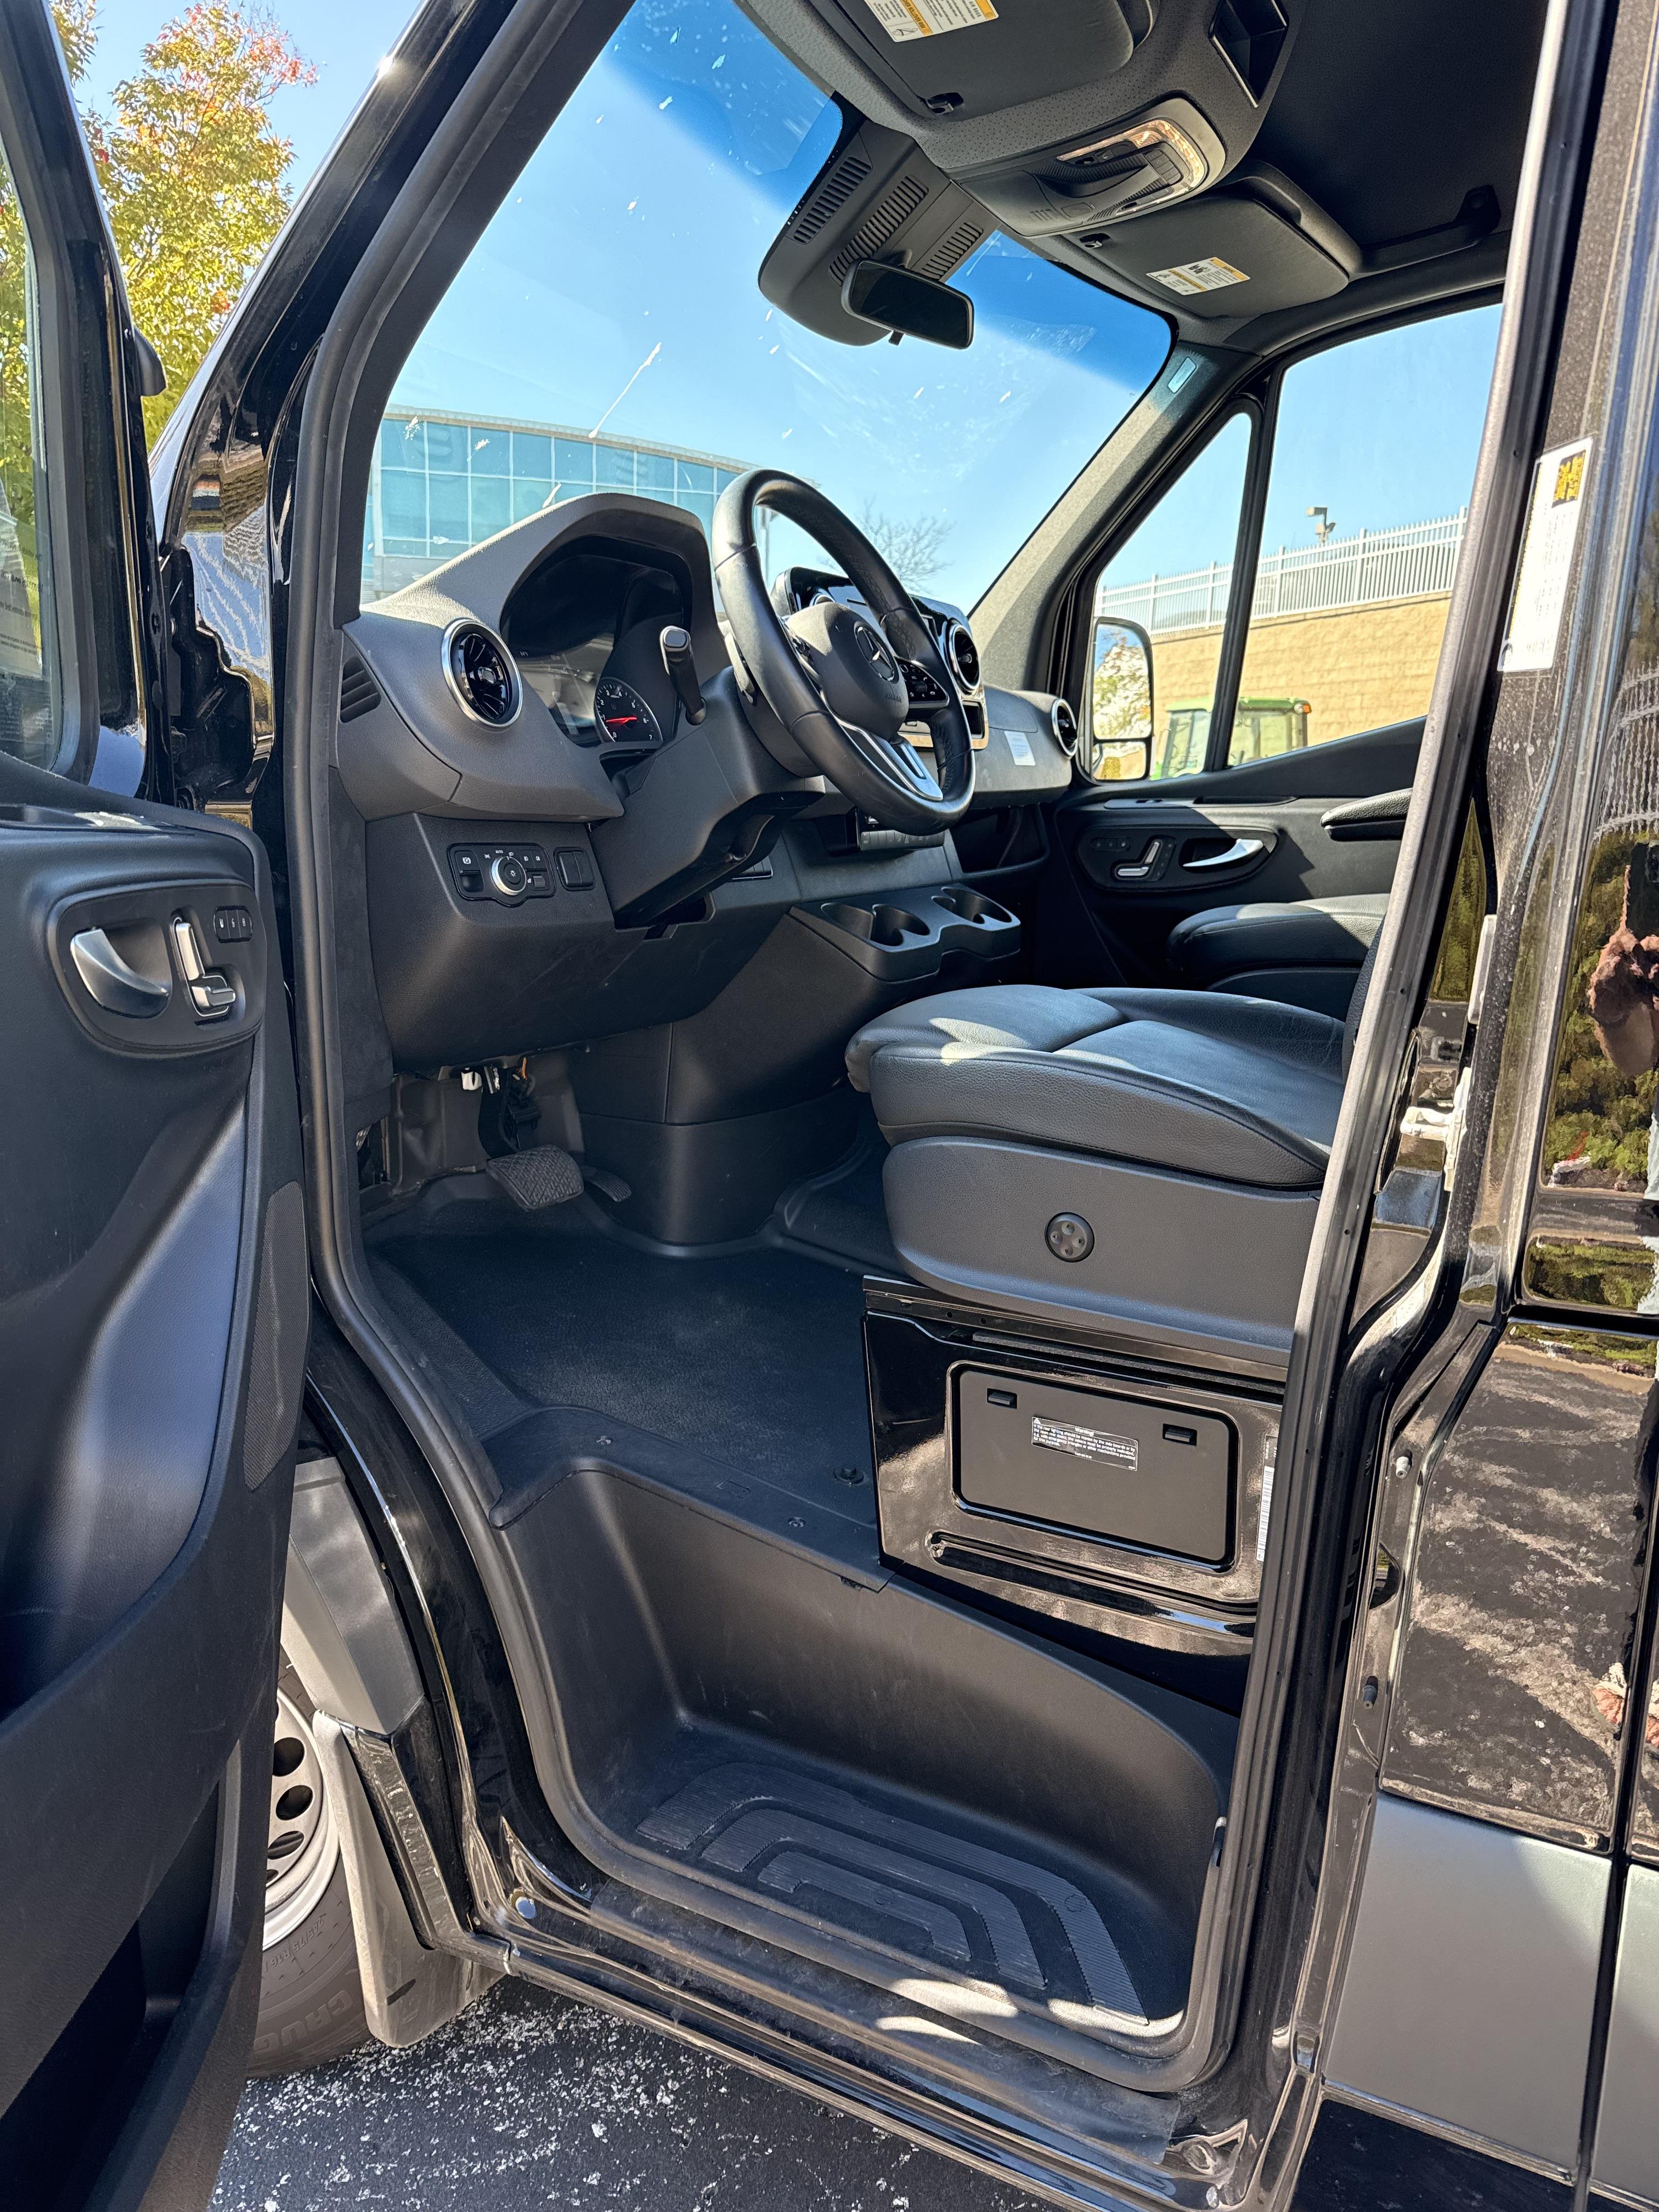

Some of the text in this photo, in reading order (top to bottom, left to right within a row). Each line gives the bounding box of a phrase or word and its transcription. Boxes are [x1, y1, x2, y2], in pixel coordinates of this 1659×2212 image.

[1075, 1427, 1093, 1436] Warning!
[293, 1917, 325, 1953] 245/75
[272, 1947, 291, 1967] R16
